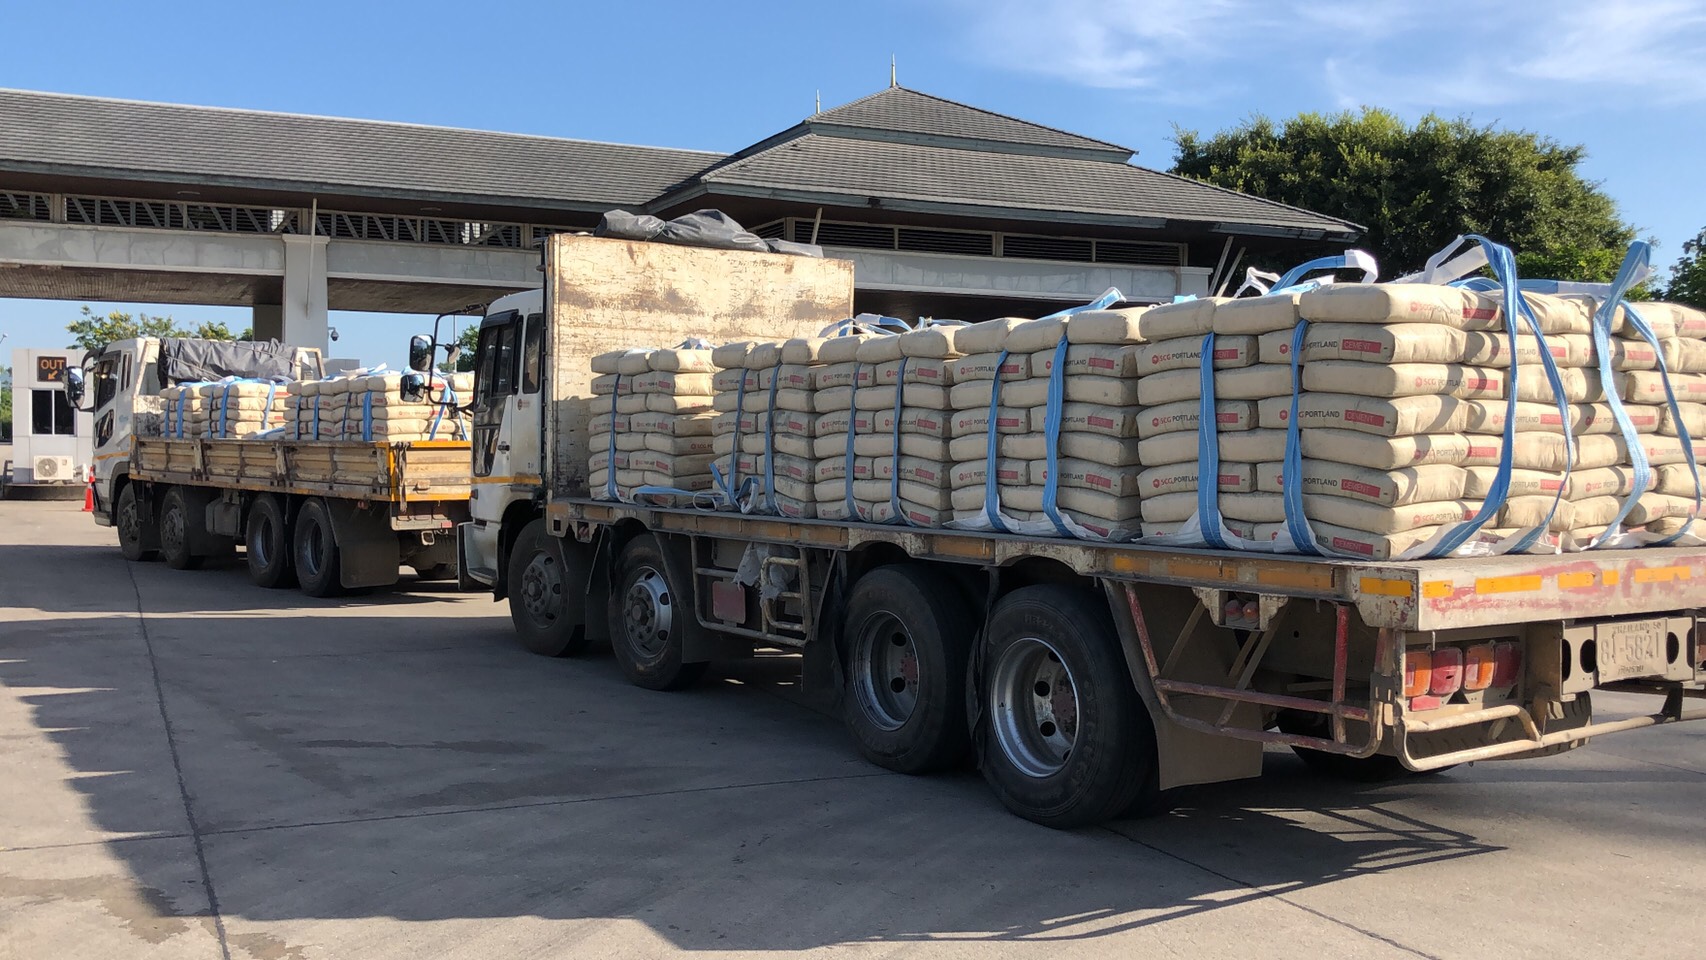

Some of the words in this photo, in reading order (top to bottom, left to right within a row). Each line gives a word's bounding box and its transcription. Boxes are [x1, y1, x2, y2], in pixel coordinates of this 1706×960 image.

[1159, 354, 1171, 362] SCG
[40, 359, 65, 370] OUT
[1305, 410, 1340, 418] PORTLAND
[1160, 416, 1172, 424] SCG
[1161, 478, 1173, 486] SCG
[1174, 475, 1198, 484] PORTLAN
[1303, 477, 1338, 487] PORTLAND
